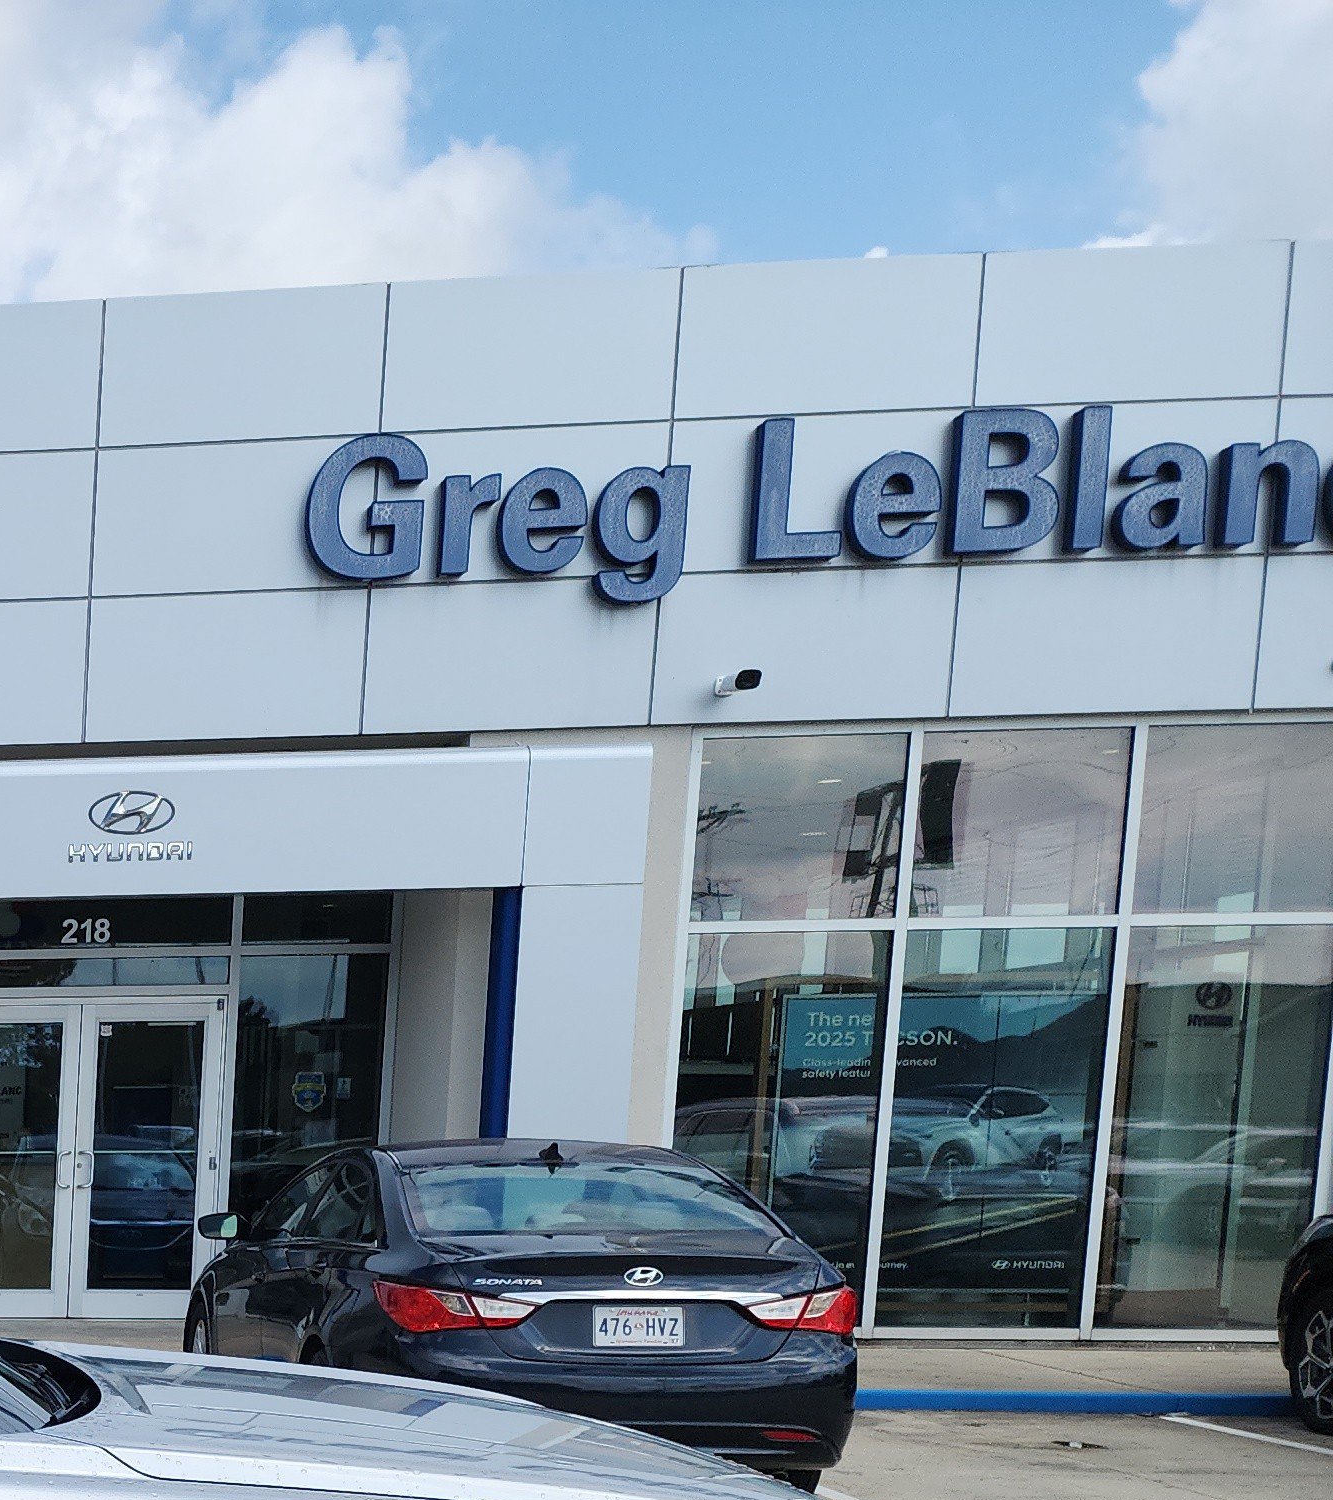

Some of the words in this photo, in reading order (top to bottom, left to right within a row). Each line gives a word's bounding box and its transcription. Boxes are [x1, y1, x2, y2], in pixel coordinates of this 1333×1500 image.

[304, 431, 691, 604] Greg
[746, 403, 1333, 562] LeBlan
[68, 841, 193, 863] HYUNDAI
[61, 918, 111, 943] 218
[808, 1012, 843, 1026] The
[849, 1012, 873, 1026] ne
[805, 1031, 855, 1047] 2025
[802, 1058, 871, 1067] Class-leadin
[896, 1057, 938, 1067] vanced
[1013, 1260, 1065, 1269] HYUNDAI
[472, 1278, 543, 1286] SONATA
[599, 1317, 632, 1336] 476
[646, 1317, 679, 1336] HVZ
